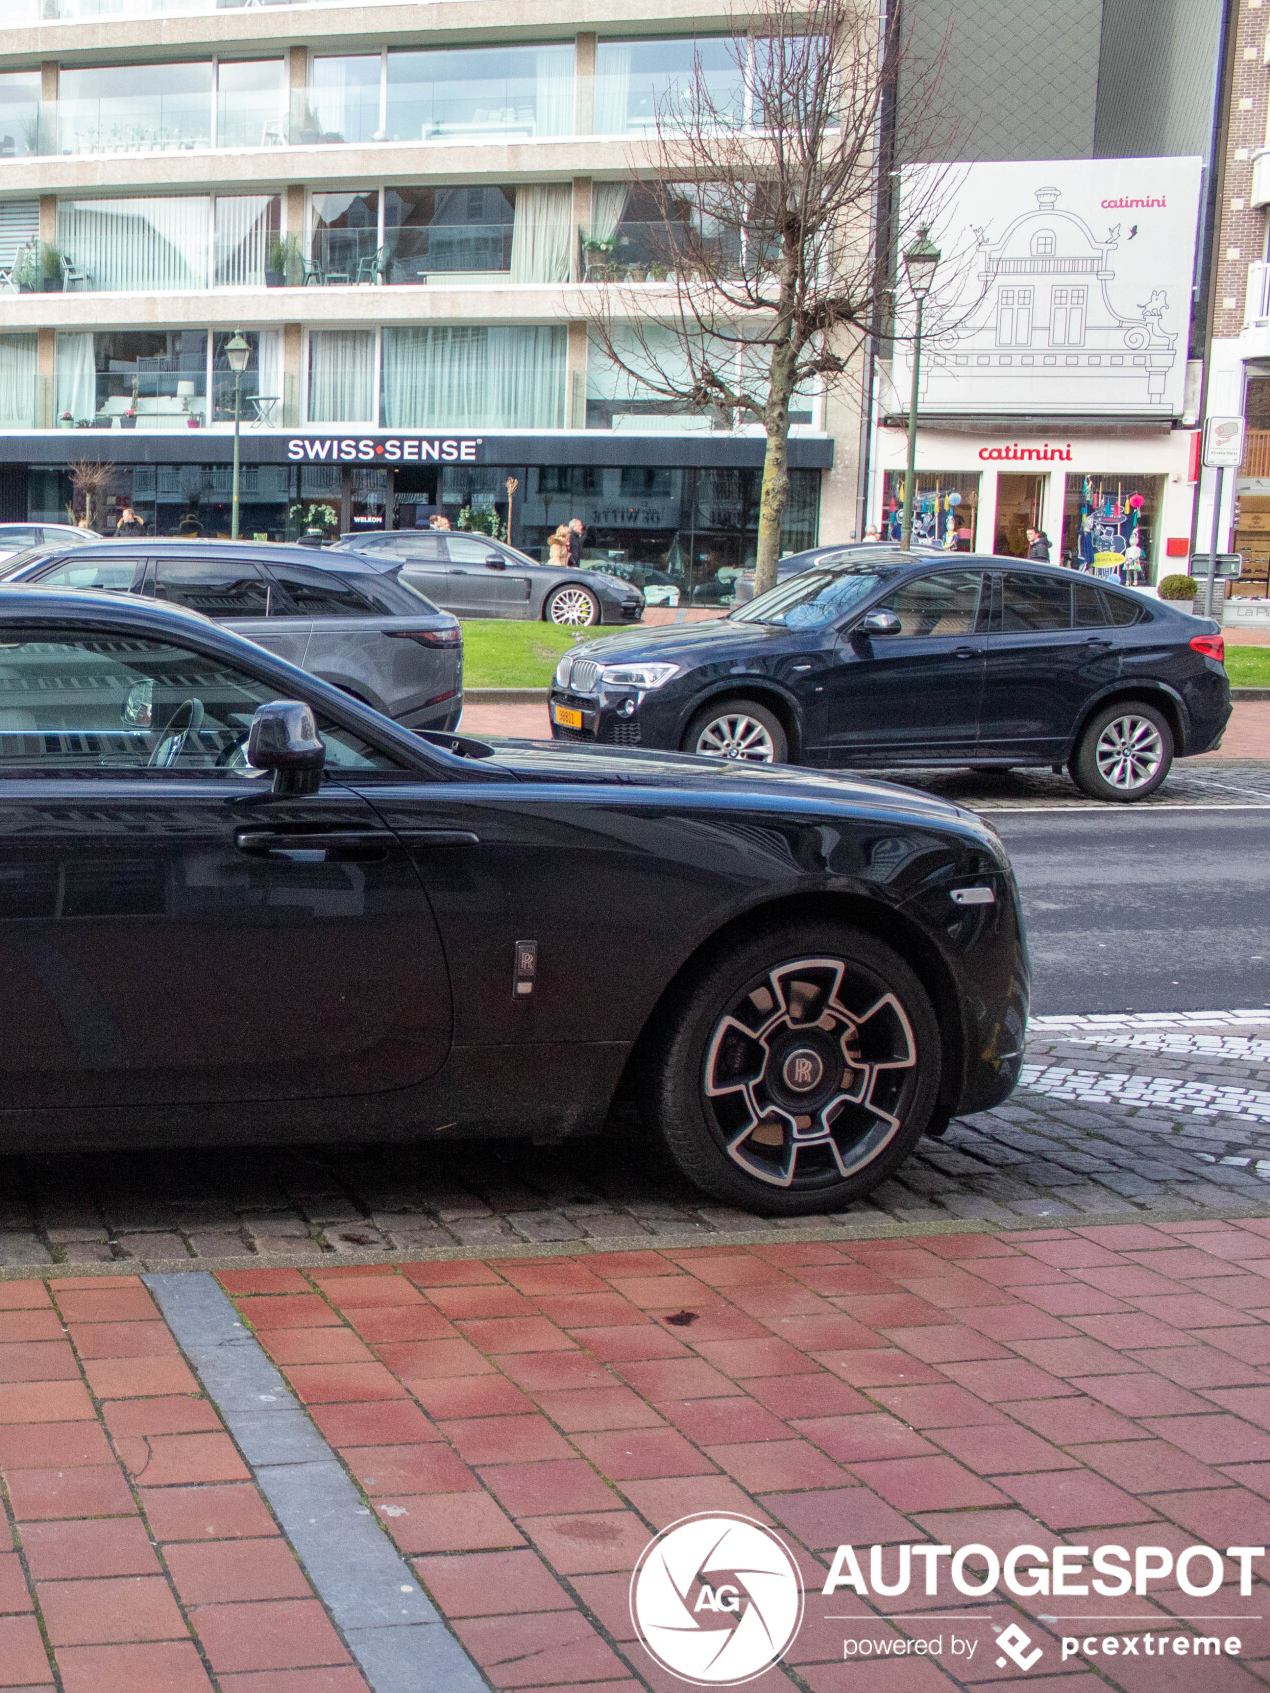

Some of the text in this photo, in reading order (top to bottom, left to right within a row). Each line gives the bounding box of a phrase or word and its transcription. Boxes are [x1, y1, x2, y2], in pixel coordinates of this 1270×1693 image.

[1100, 195, 1167, 209] catimini
[287, 439, 375, 460] SWISS
[978, 443, 1073, 461] catimini
[353, 515, 383, 523] WELKOM
